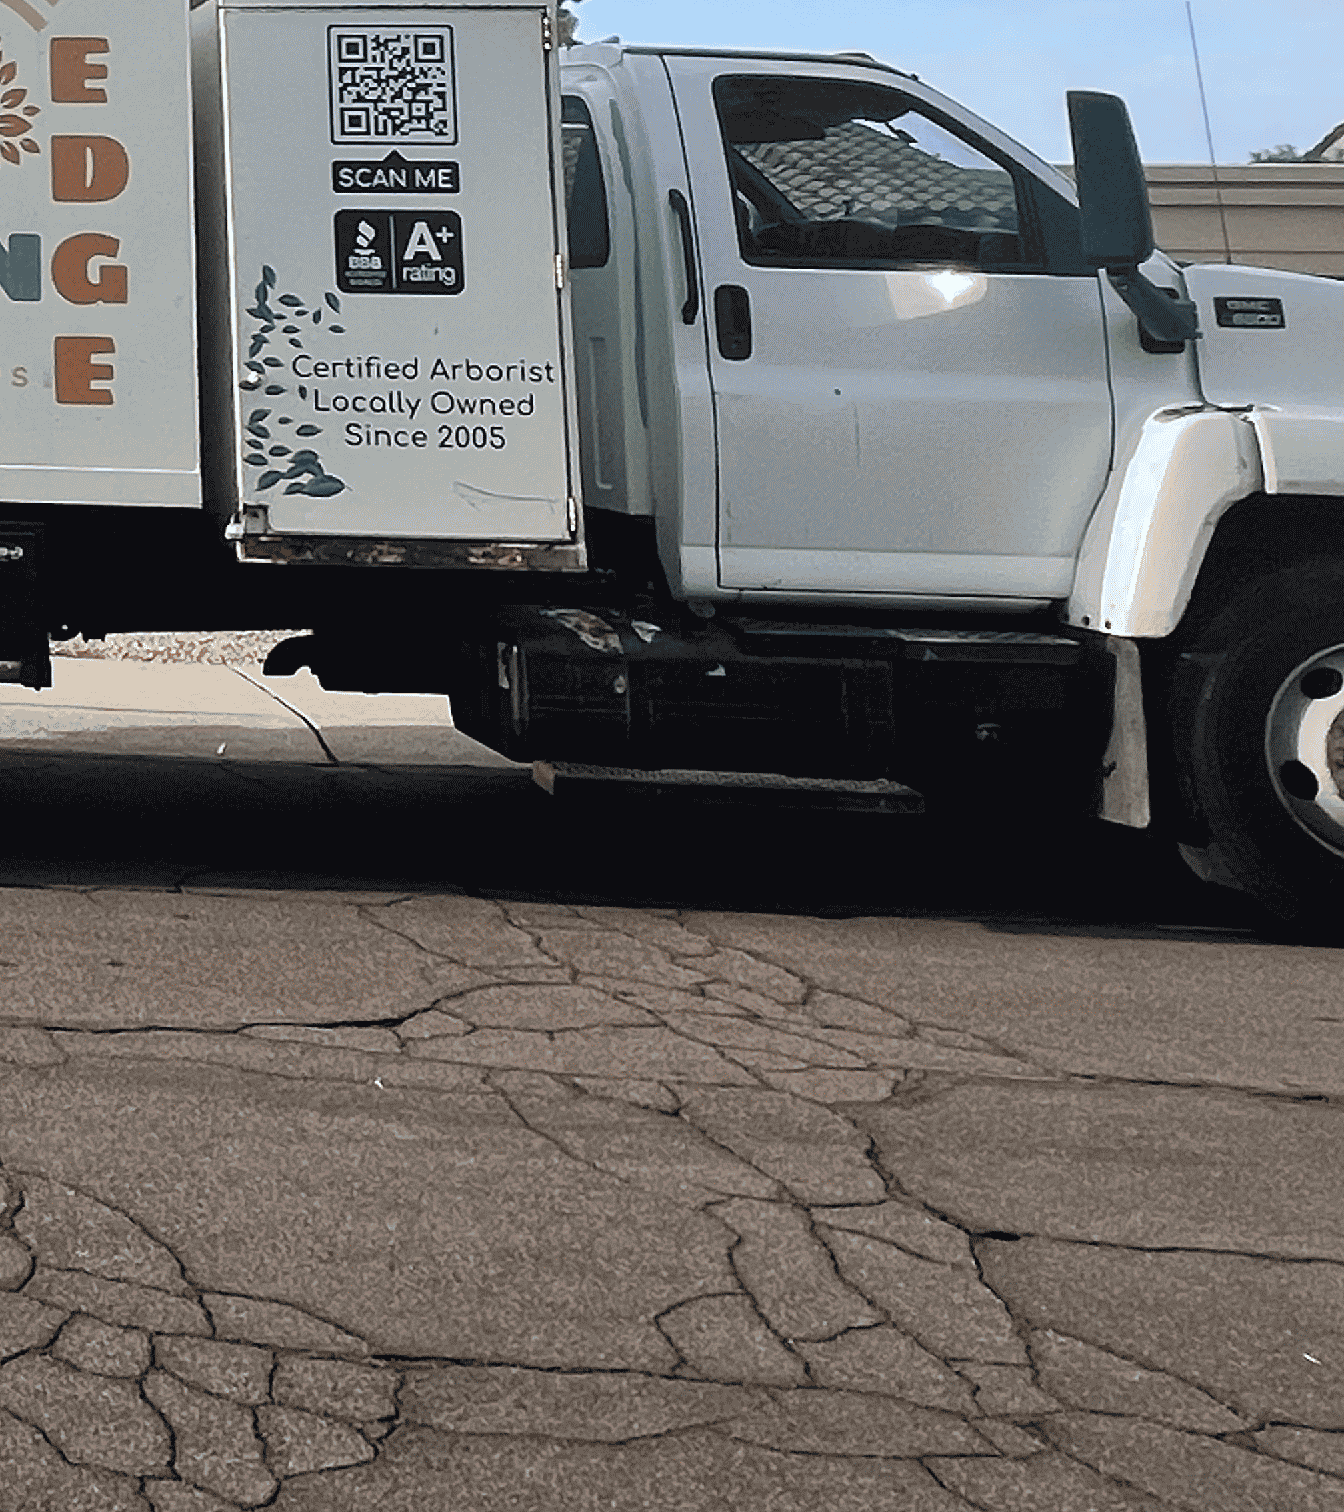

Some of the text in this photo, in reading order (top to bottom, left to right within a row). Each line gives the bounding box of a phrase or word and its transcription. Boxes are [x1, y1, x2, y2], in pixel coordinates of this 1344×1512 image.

[338, 168, 454, 188] SCAN ME
[50, 37, 129, 405] EDGE
[401, 262, 456, 286] rating
[292, 354, 555, 383] Certified Arborist
[313, 388, 535, 420] Locally Owned
[344, 423, 507, 450] Since 2005
